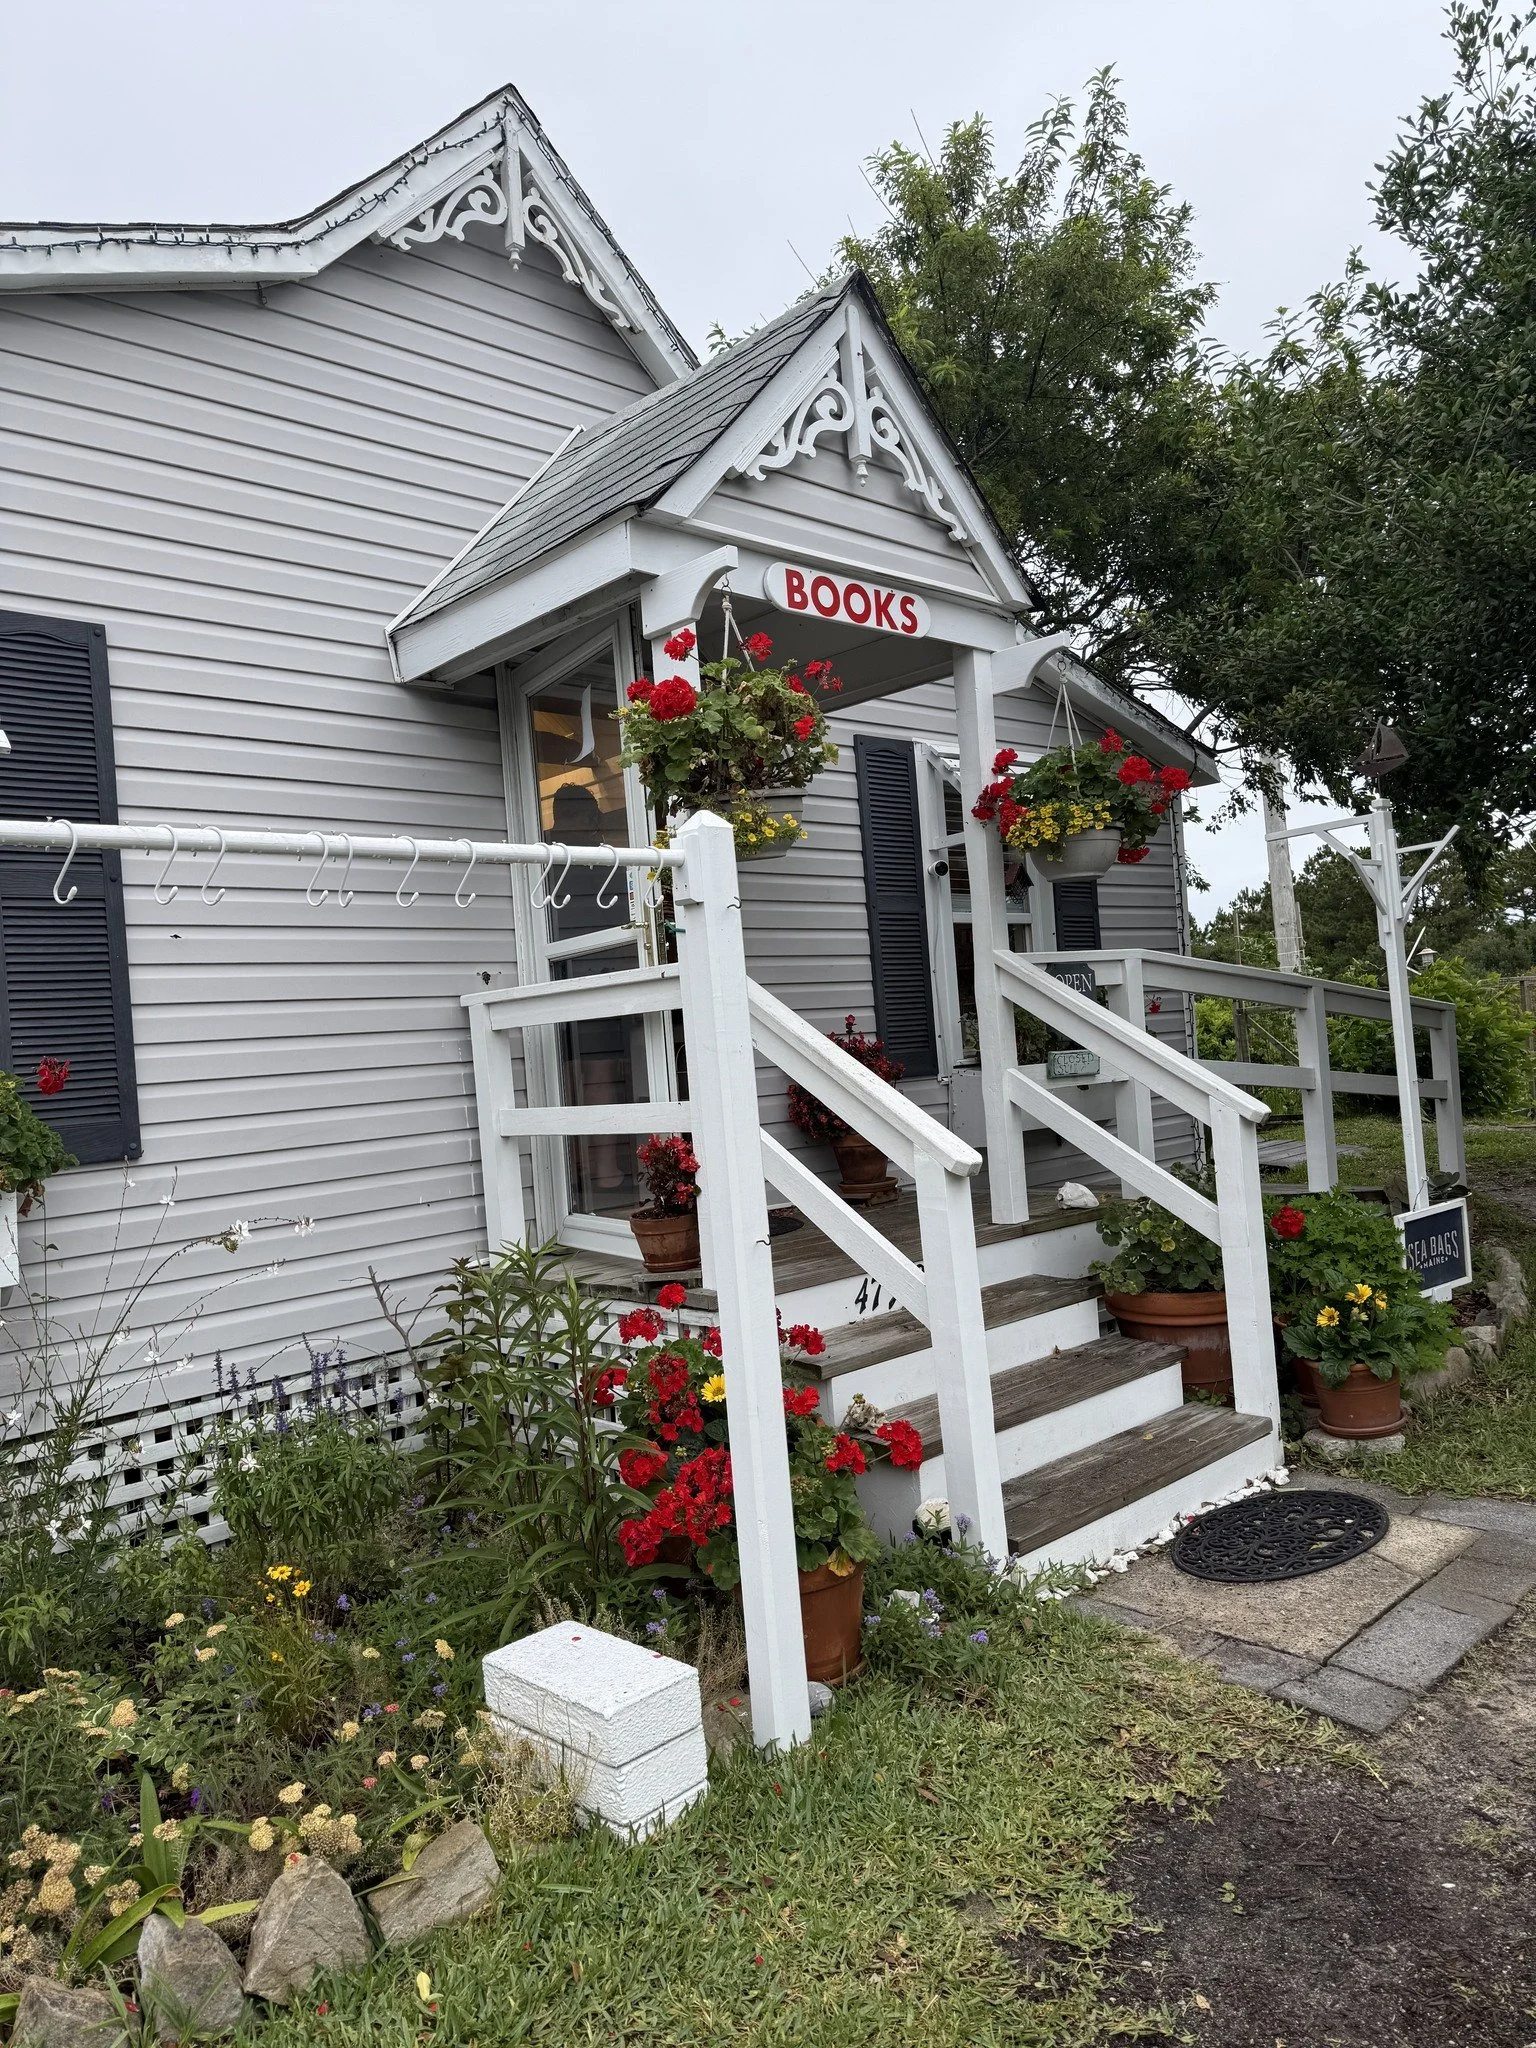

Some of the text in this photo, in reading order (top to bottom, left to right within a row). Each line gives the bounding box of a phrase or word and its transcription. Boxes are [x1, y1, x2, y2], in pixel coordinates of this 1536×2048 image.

[784, 567, 918, 635] BOOKS
[1056, 1052, 1095, 1065] CLOSED
[1407, 1230, 1459, 1271] SEA BAGS
[1423, 1256, 1446, 1269] MAINE
